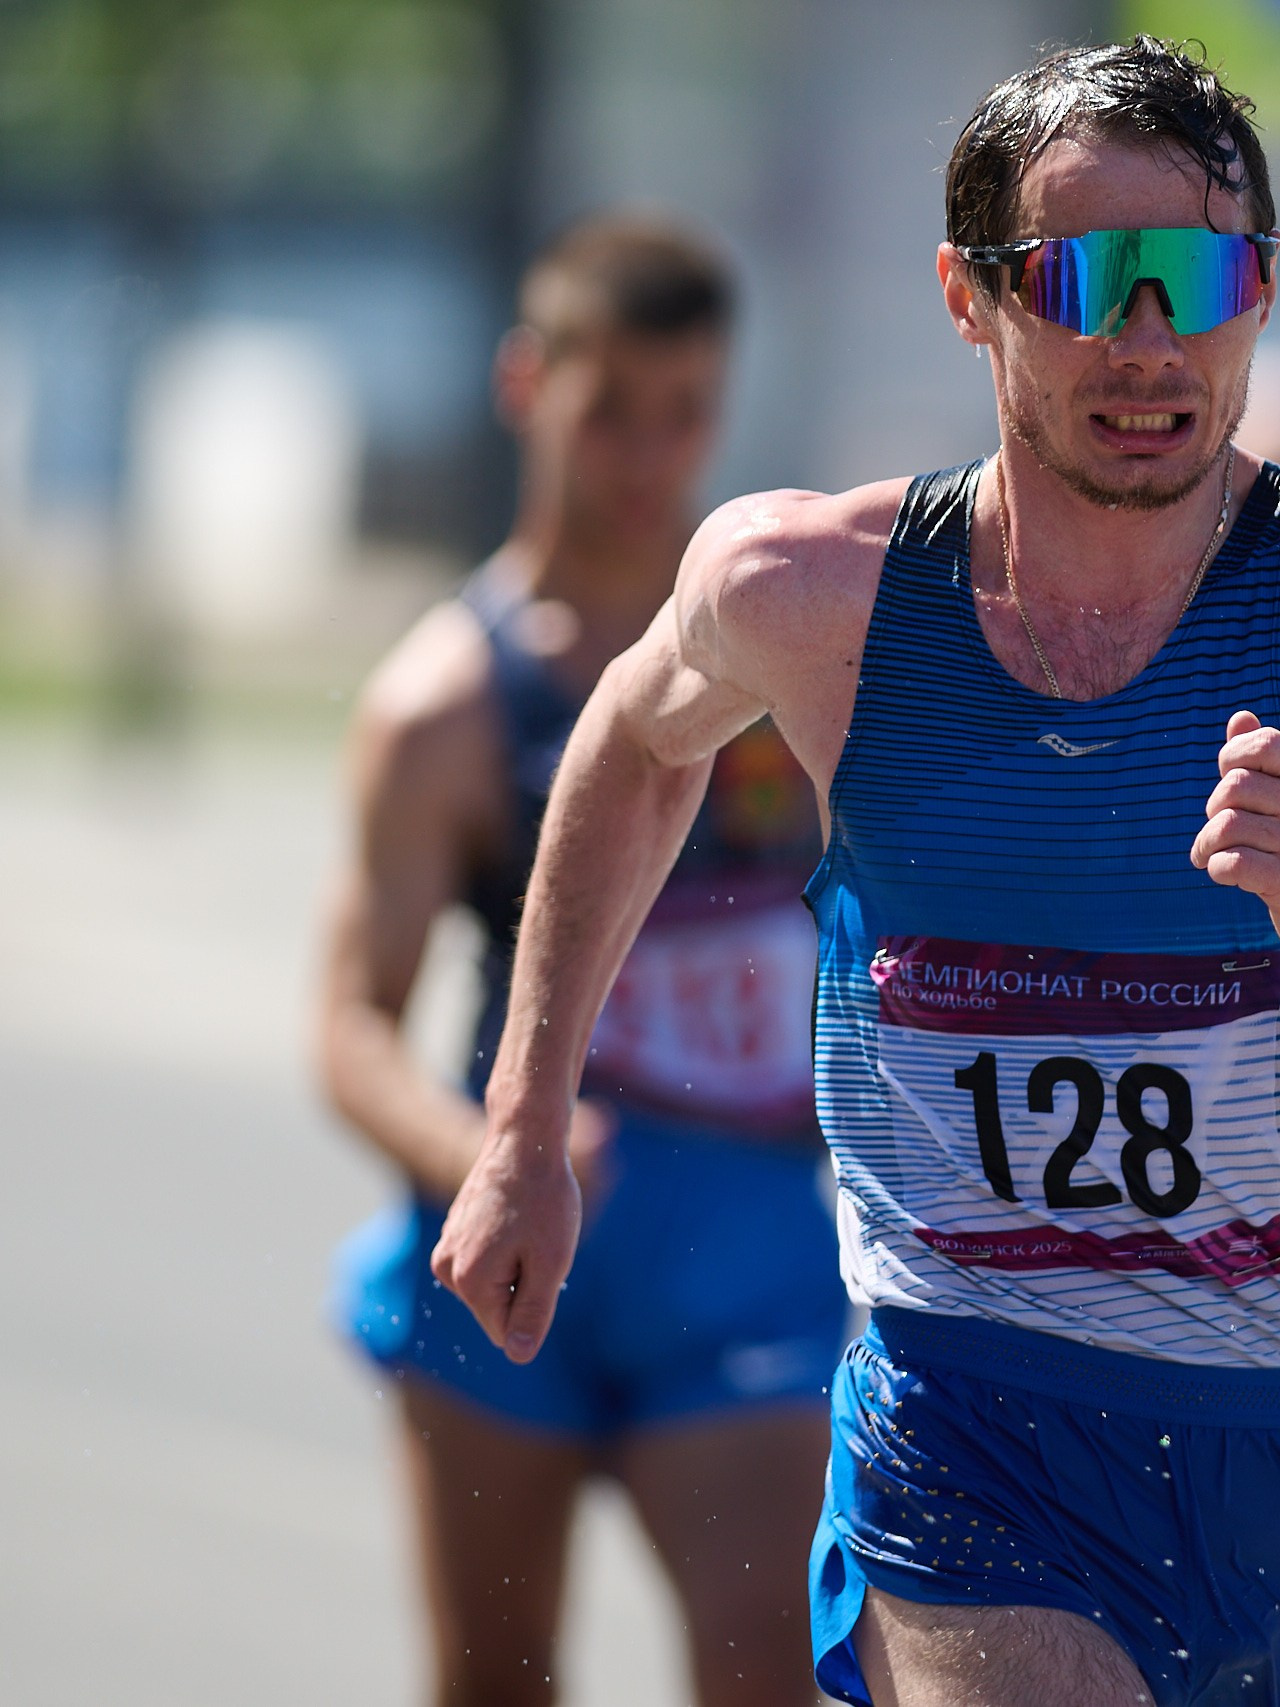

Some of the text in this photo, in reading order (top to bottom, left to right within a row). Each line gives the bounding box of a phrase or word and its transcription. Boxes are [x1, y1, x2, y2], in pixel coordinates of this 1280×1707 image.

[892, 982, 997, 1010] по ходьбе
[1101, 981, 1241, 1006] РОССИИ
[954, 1051, 1201, 1217] 128
[1030, 1240, 1072, 1255] 2025
